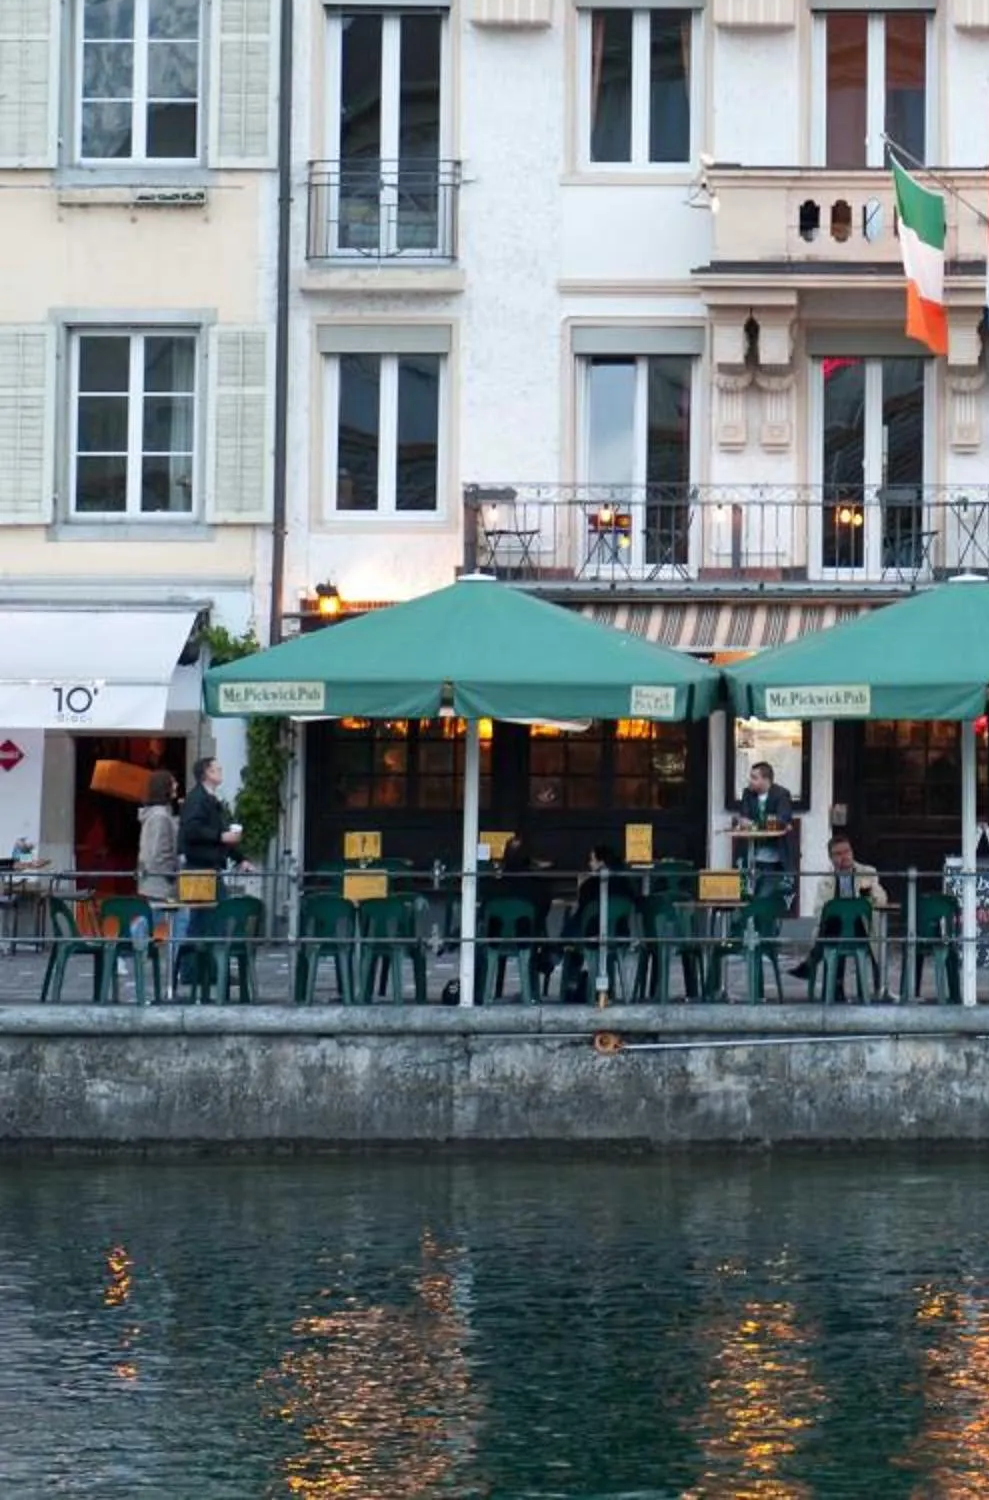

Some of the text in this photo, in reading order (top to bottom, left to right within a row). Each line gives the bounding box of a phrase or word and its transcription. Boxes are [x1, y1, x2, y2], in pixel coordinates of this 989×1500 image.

[243, 687, 297, 701] Pickwick
[297, 686, 321, 701] Pub
[789, 691, 842, 707] Pickwick
[843, 691, 867, 705] Pub
